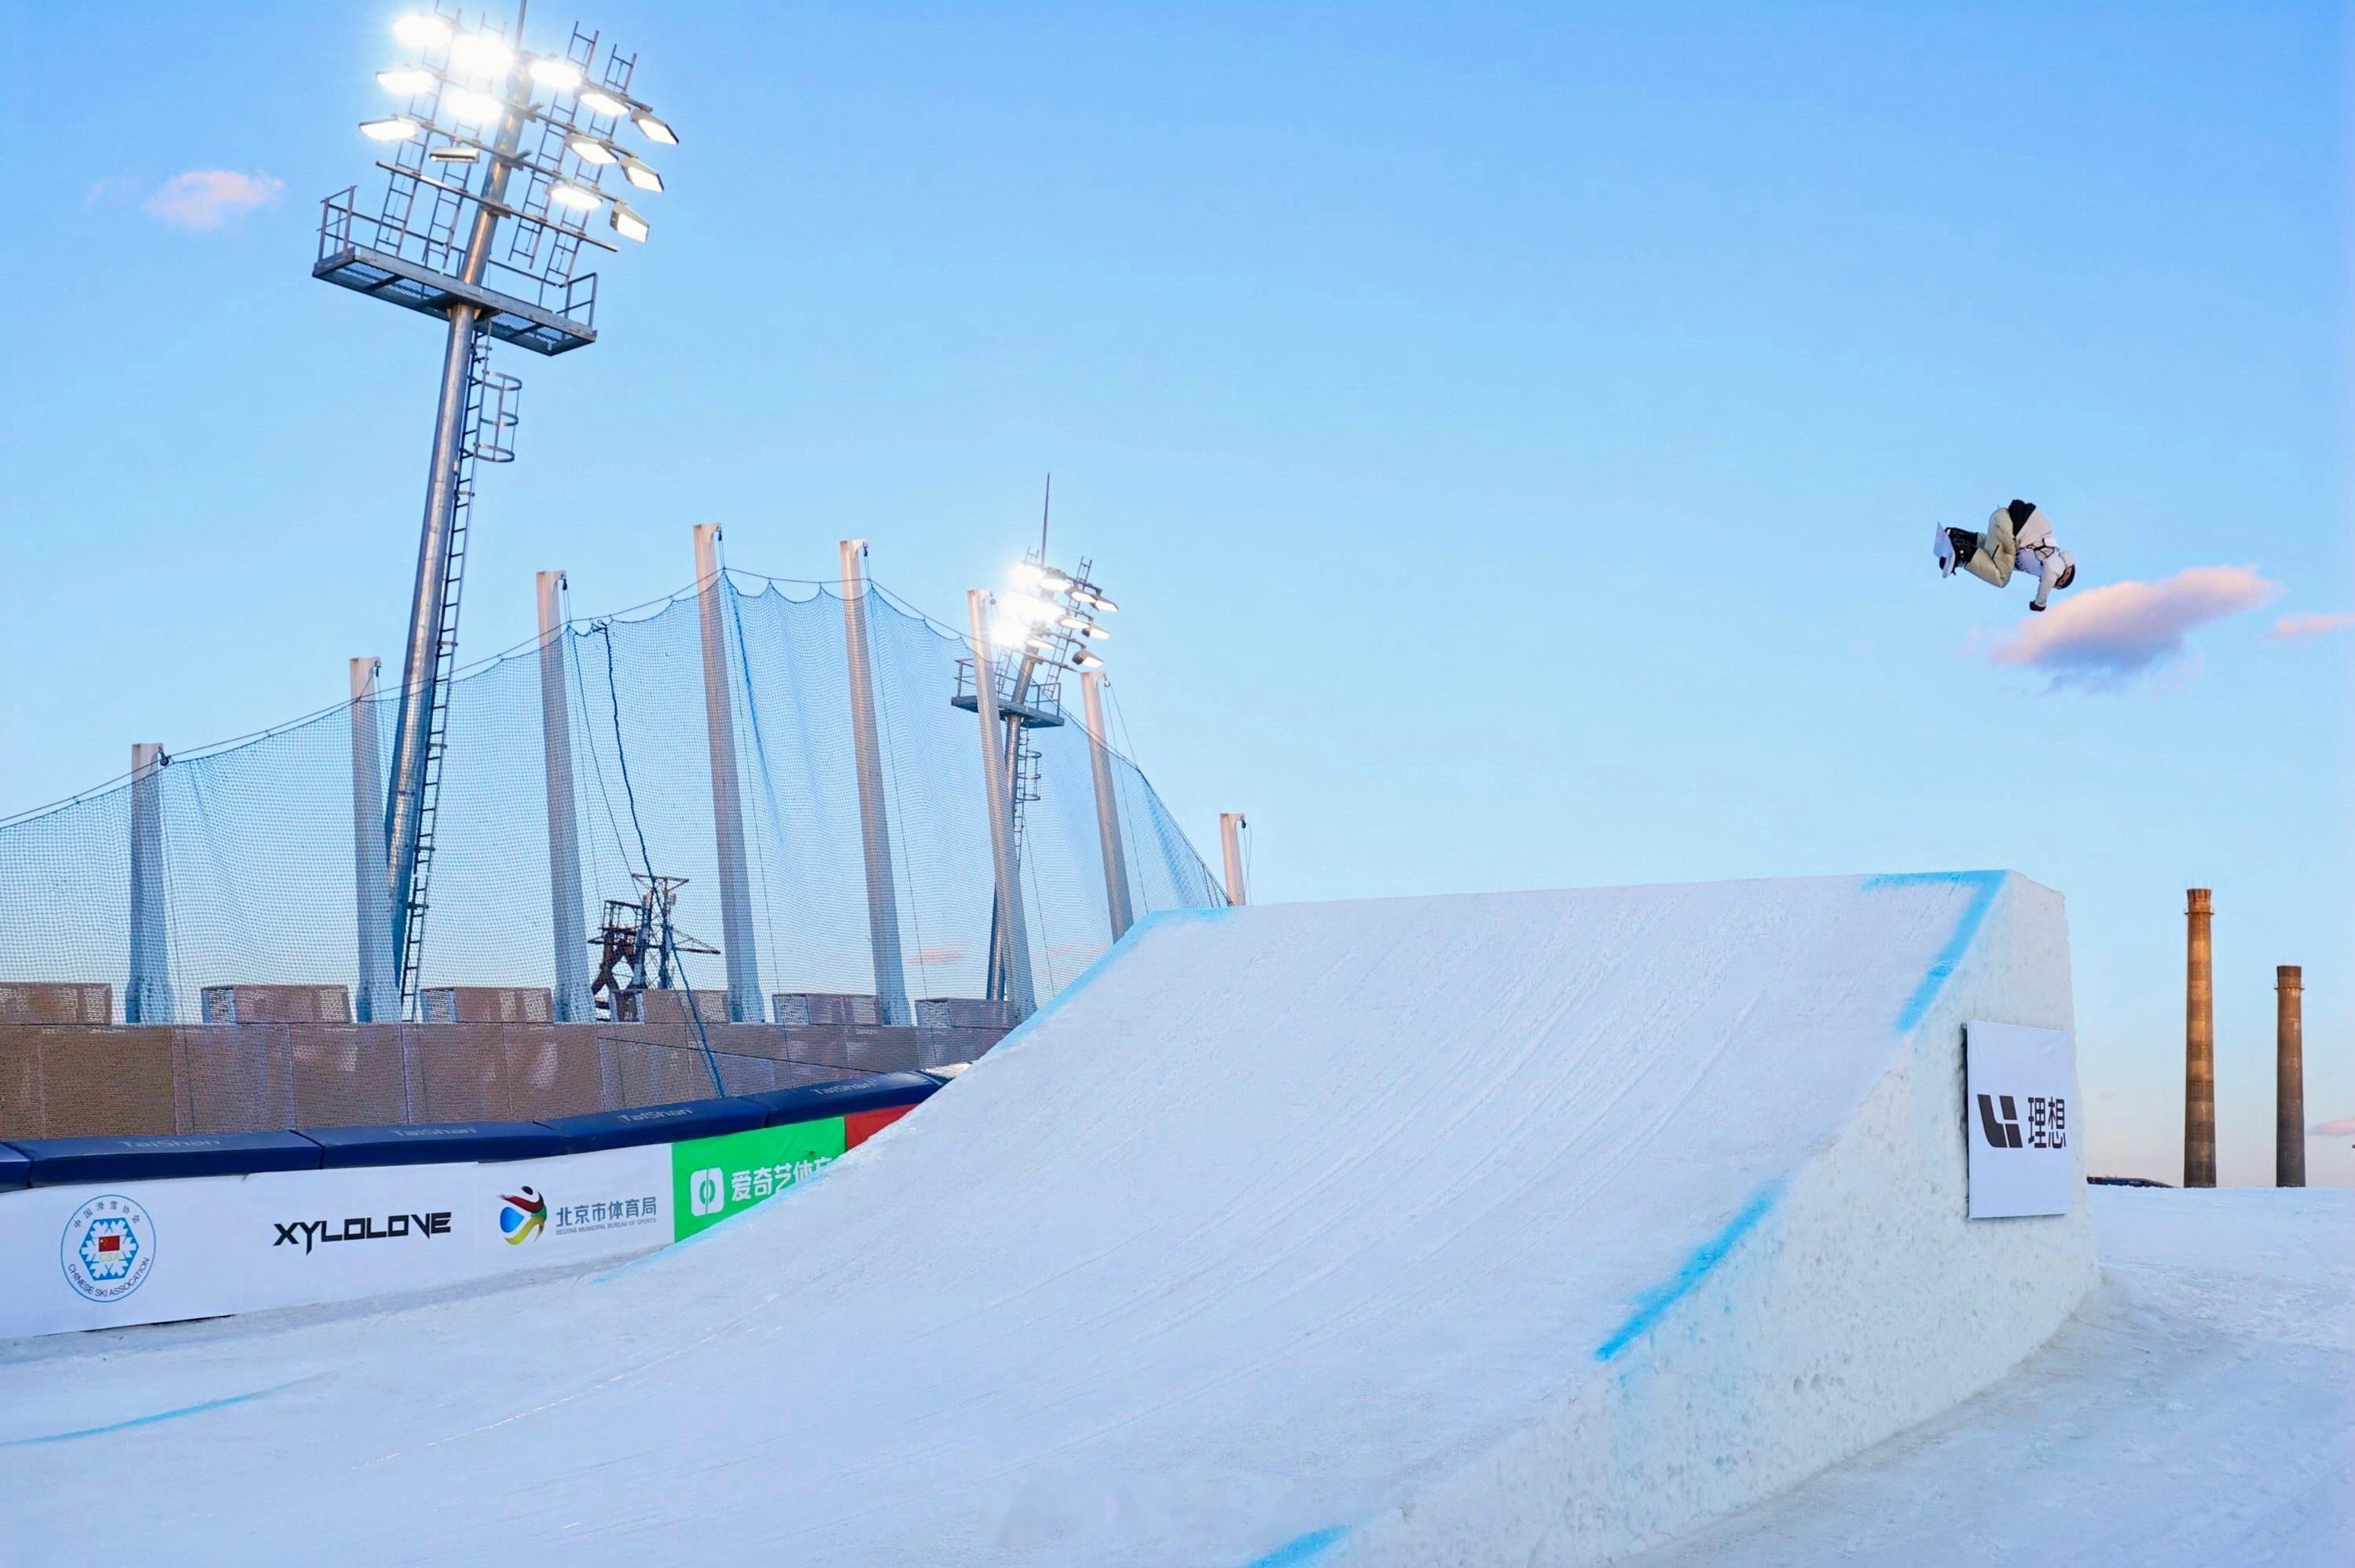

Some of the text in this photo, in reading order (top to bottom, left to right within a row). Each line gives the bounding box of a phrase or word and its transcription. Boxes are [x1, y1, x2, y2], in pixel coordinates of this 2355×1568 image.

[618, 1108, 694, 1123] TaiShan
[2027, 1096, 2067, 1149] 理想
[391, 1127, 477, 1137] TaiShan
[556, 1196, 657, 1227] 北京市体育局
[273, 1211, 452, 1256] XYLOLOVE
[556, 1226, 578, 1236] BEIJING
[578, 1222, 607, 1233] MUNICIPAL
[607, 1220, 628, 1229] BUREAU
[68, 1263, 94, 1295] CHINESE
[94, 1288, 108, 1298] SKI
